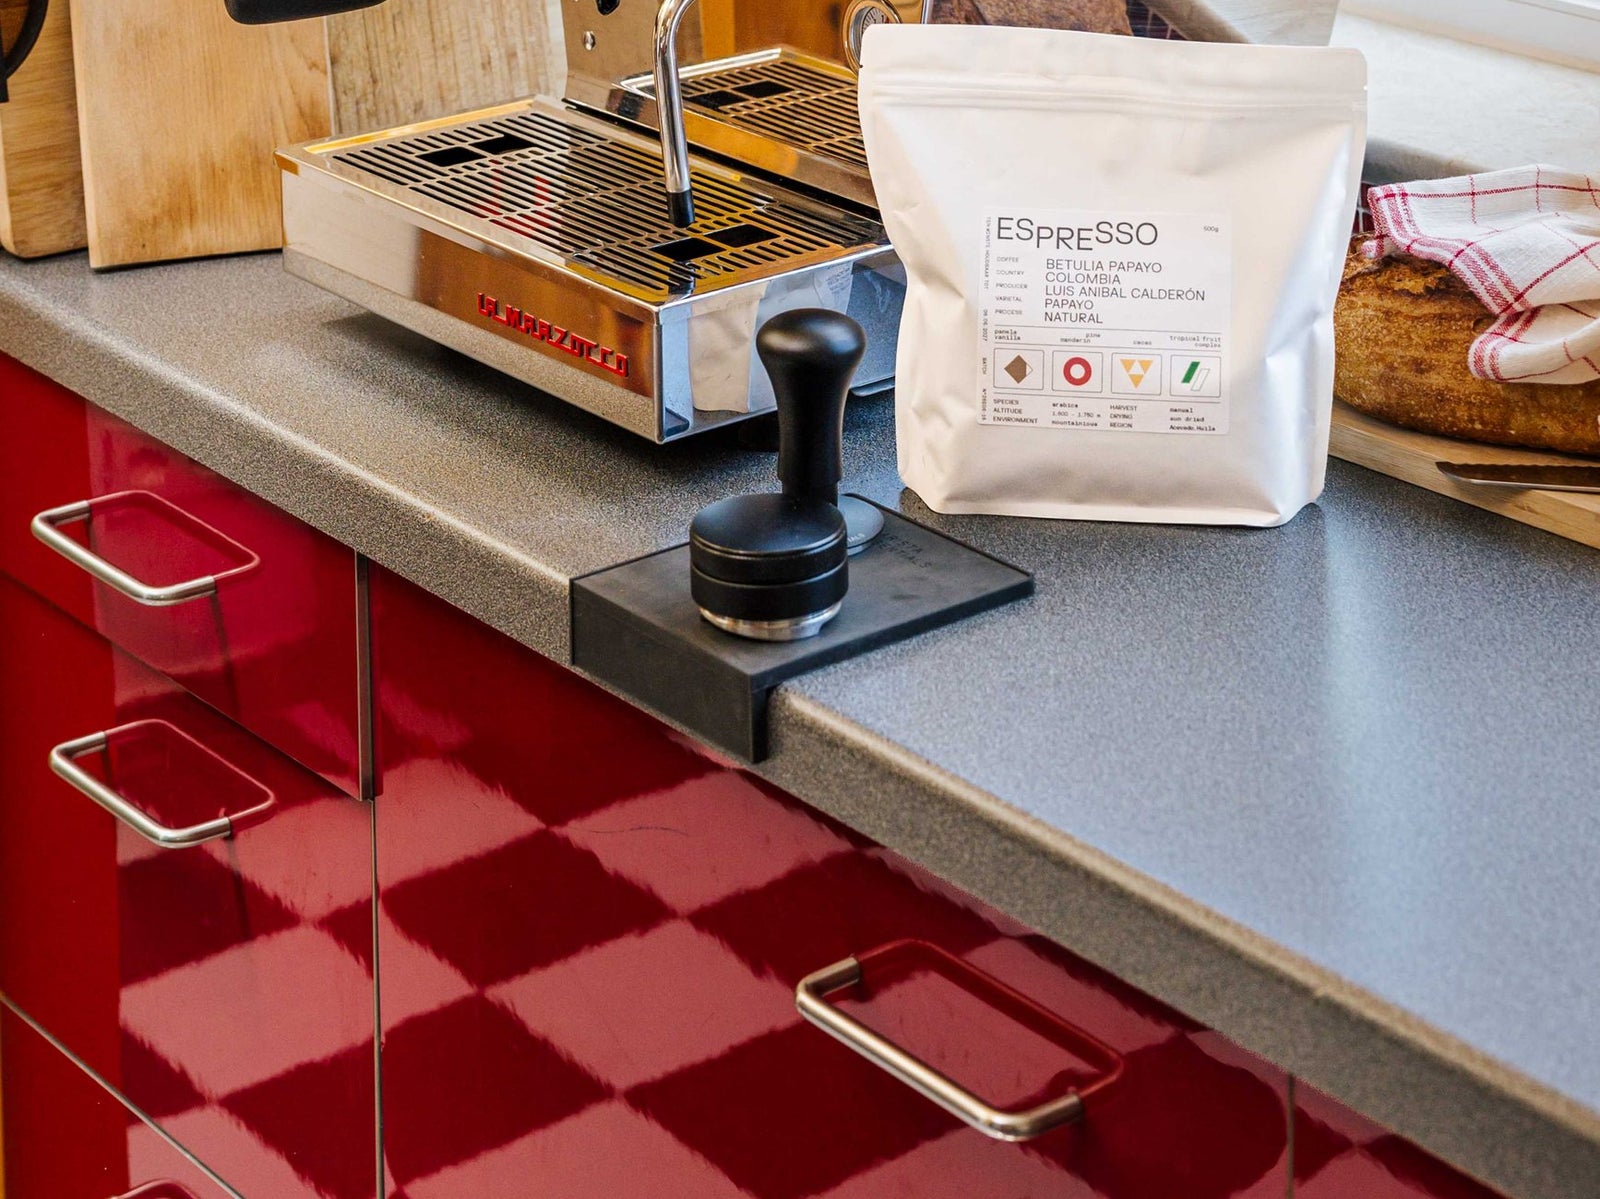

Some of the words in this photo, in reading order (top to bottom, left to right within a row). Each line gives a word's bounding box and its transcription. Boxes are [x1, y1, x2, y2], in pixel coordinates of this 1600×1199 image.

[997, 216, 1158, 251] ESPRESSO
[1203, 225, 1219, 233] 500g
[1046, 258, 1104, 271] BETULIA
[1108, 260, 1162, 274] PAPAYO
[1045, 271, 1121, 285] COLOMBIA
[996, 282, 1028, 290] PRODUCER
[1045, 285, 1075, 297] LUIS
[1079, 286, 1128, 299] ANIBAL
[1130, 287, 1206, 301] CALDERÓN
[478, 293, 497, 317] LA
[1044, 298, 1094, 311] PAPAYO
[1044, 311, 1104, 324] NATURAL
[994, 328, 1017, 336] panela
[993, 407, 1023, 415] ALTITUDE
[1110, 404, 1138, 412] HARVEST
[993, 416, 1039, 424] ENVIRONMENT
[1109, 421, 1133, 429] REGION
